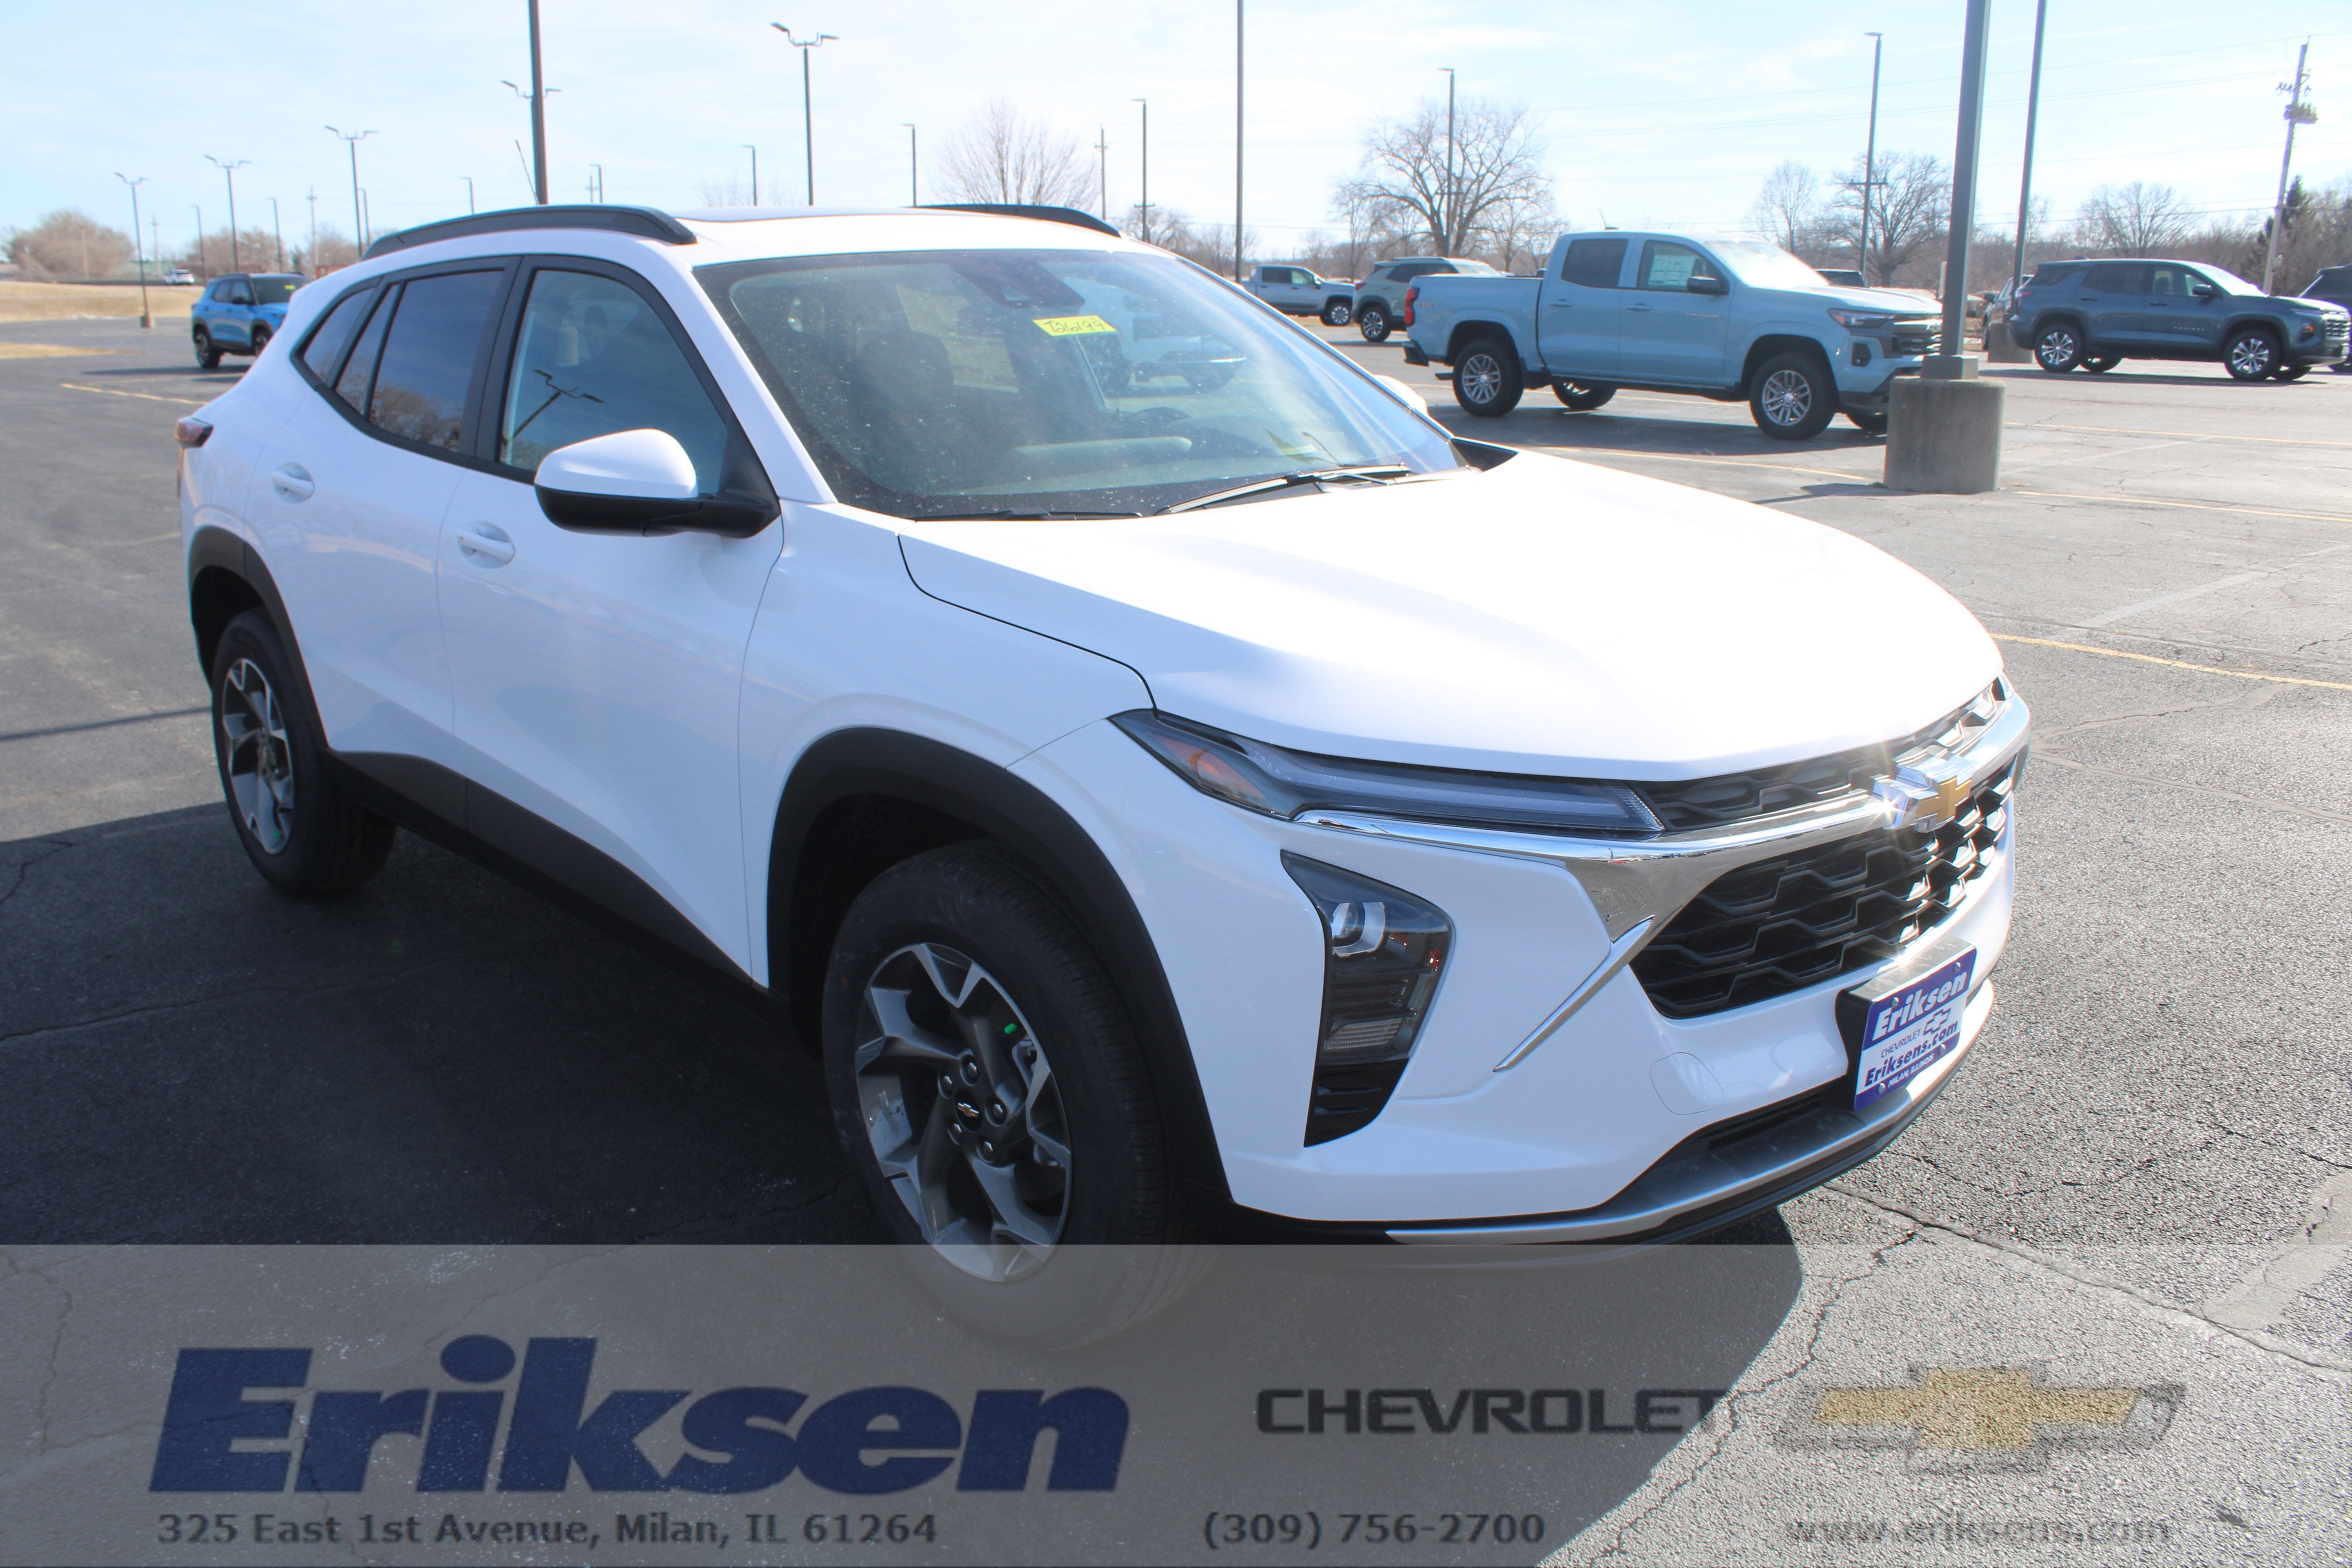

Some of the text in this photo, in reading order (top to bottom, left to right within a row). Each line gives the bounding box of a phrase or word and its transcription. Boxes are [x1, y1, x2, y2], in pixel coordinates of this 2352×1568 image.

[1872, 972, 1967, 1041] Eriksen
[1864, 1021, 1958, 1087] Eriksens.com
[1881, 1028, 1922, 1058] CHEVROLET
